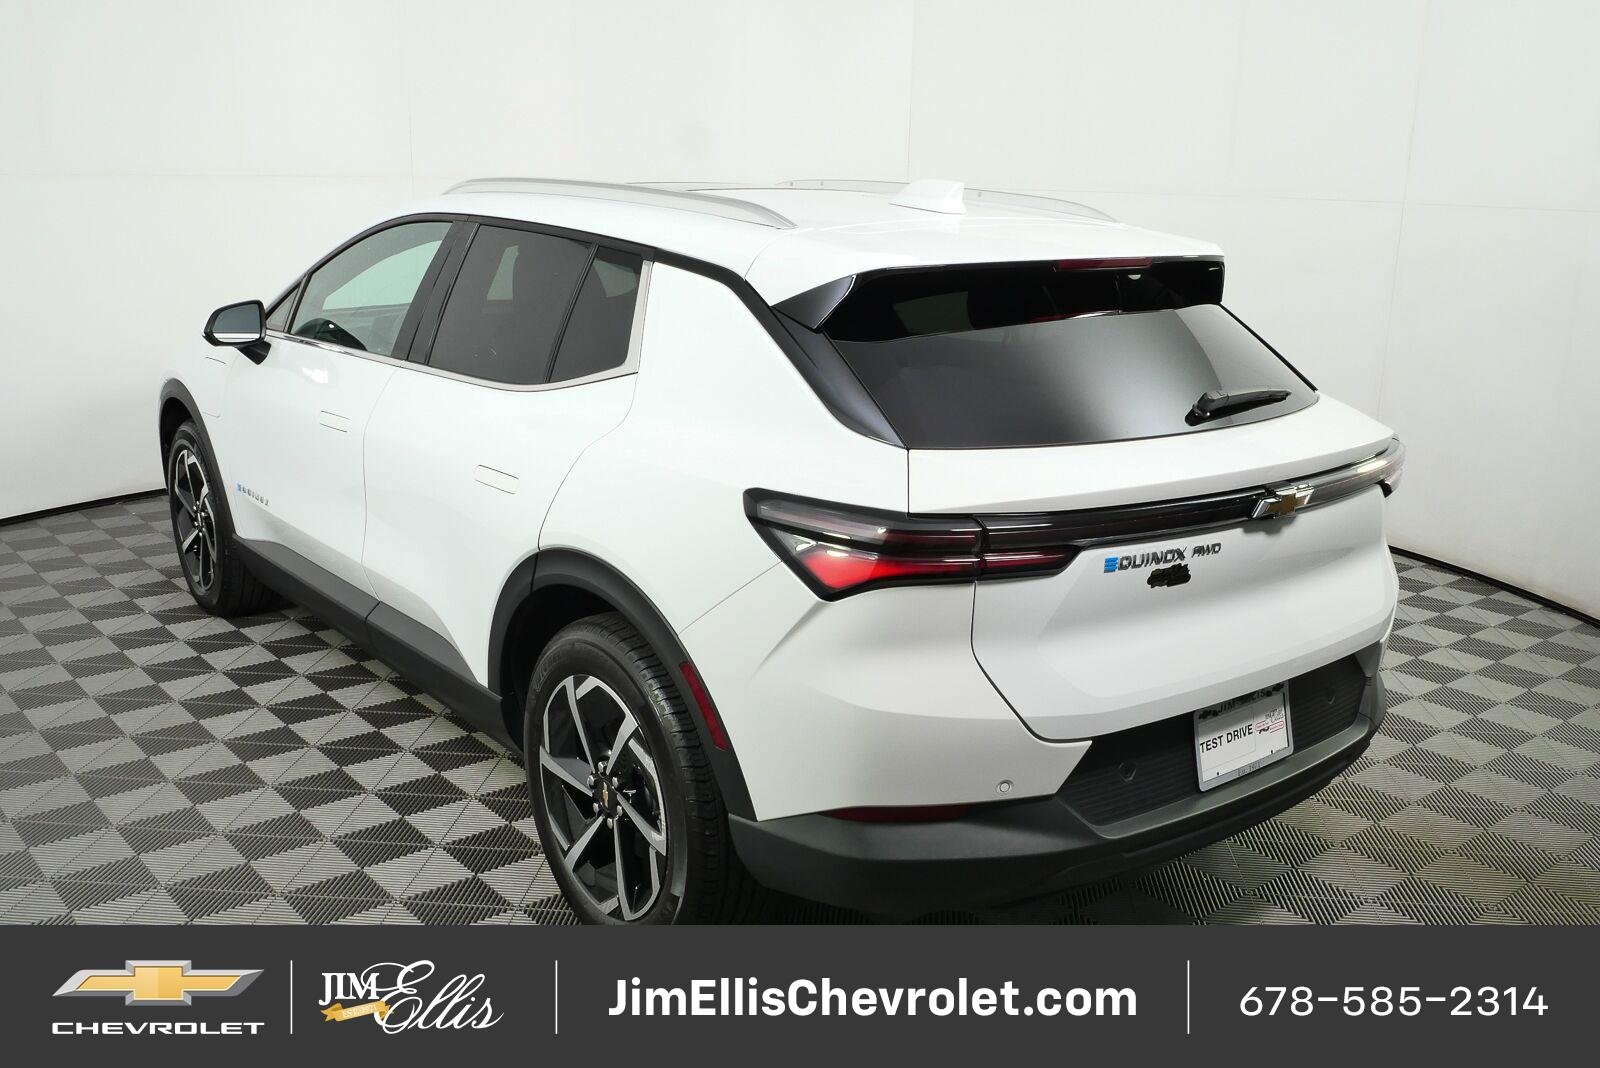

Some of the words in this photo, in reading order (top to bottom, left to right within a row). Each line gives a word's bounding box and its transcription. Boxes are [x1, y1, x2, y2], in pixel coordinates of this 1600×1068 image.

[1103, 546, 1188, 573] EQUINOX
[1191, 542, 1222, 558] AWD
[1200, 735, 1224, 753] TEST
[1227, 724, 1253, 743] DRIVE
